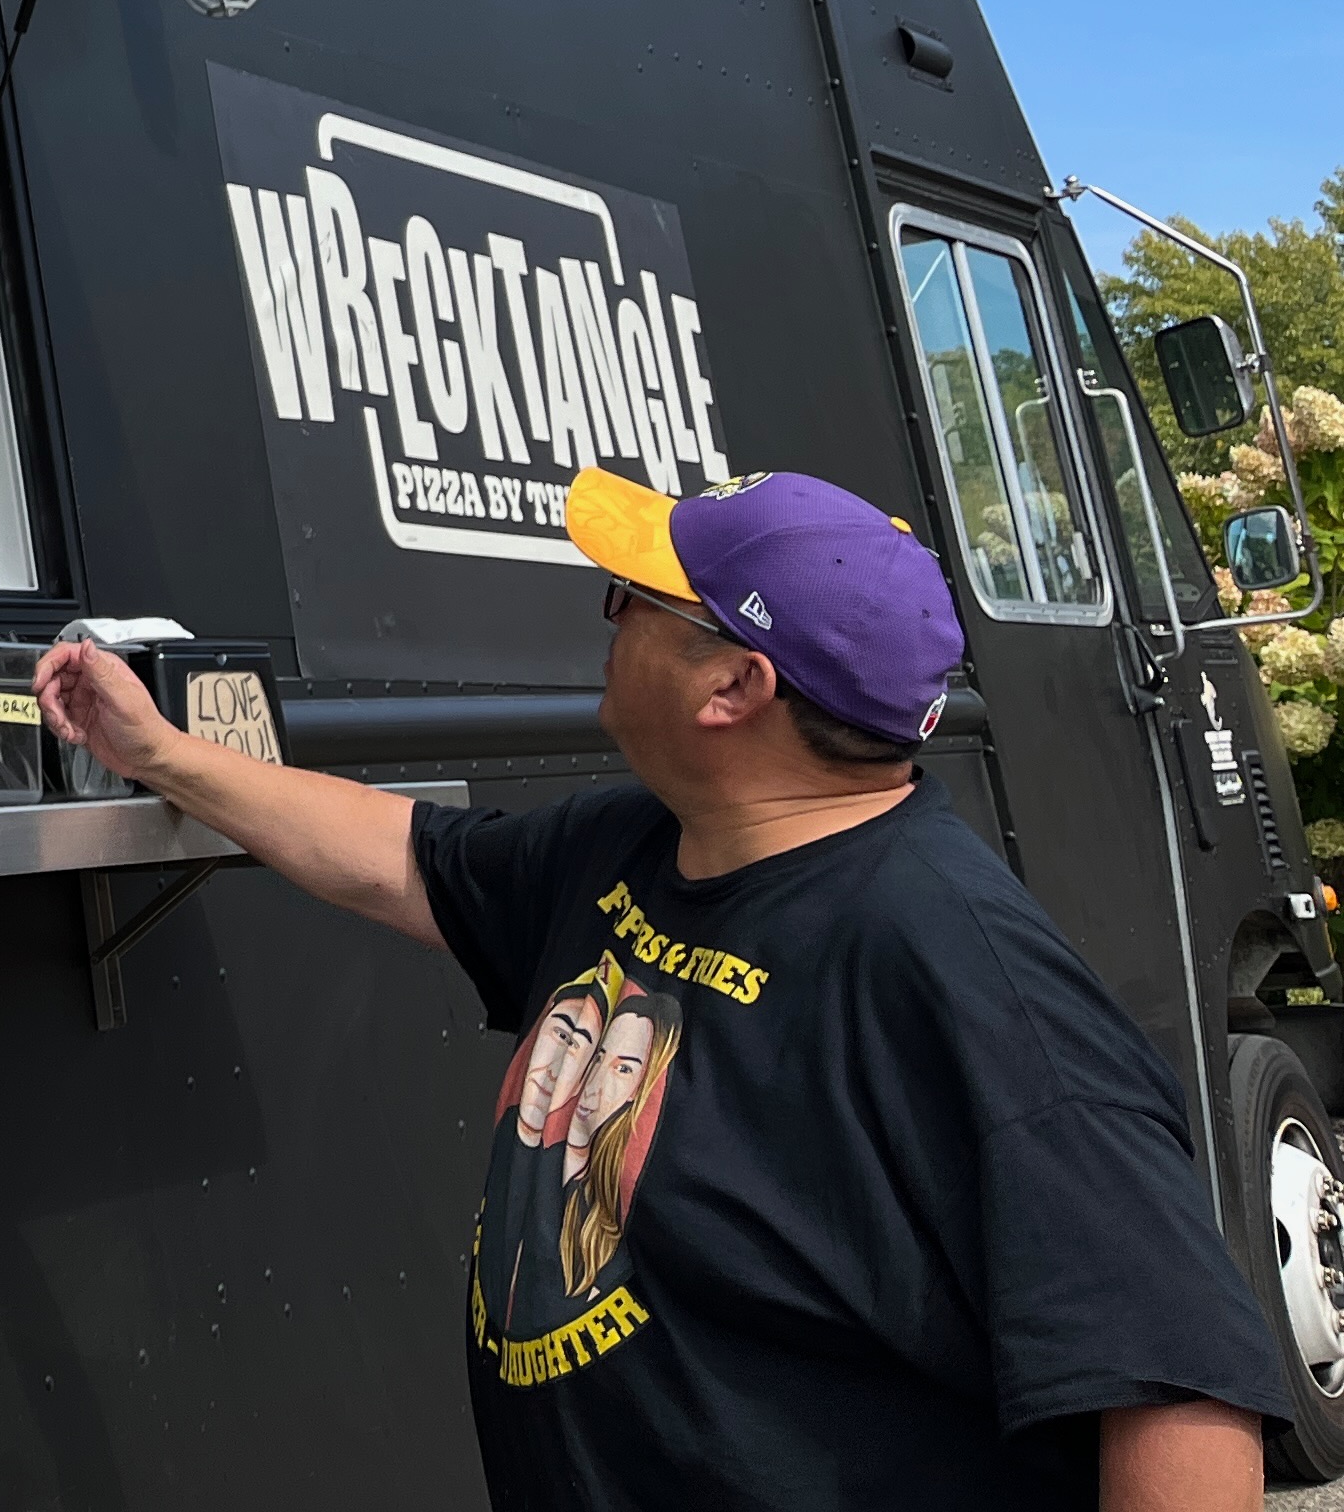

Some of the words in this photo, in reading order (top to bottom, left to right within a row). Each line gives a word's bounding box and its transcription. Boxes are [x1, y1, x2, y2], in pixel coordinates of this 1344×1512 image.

[226, 165, 729, 497] WRECKTANGLE
[392, 462, 486, 518] PIZZA
[484, 474, 524, 523] BY
[525, 480, 570, 528] TH
[198, 674, 262, 726] LOVE
